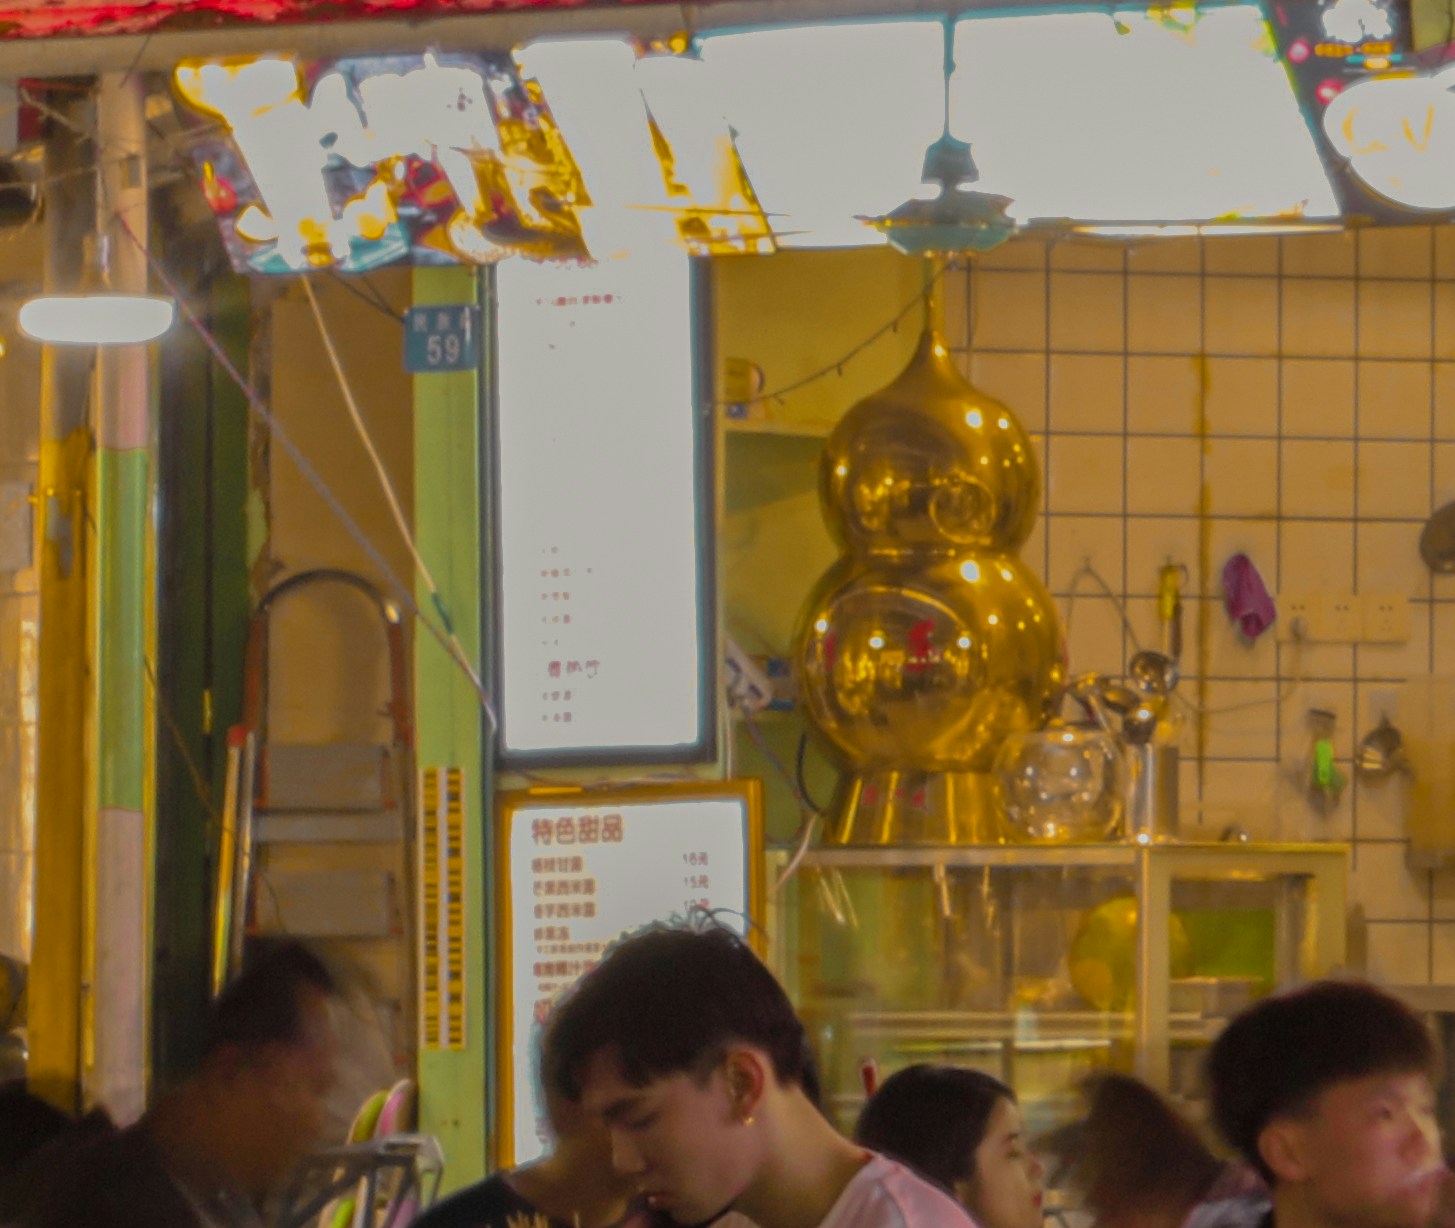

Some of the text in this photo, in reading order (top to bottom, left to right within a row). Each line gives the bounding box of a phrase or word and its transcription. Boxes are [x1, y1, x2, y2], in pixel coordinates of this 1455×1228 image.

[426, 334, 460, 365] 59
[531, 813, 624, 846] 特色甜品
